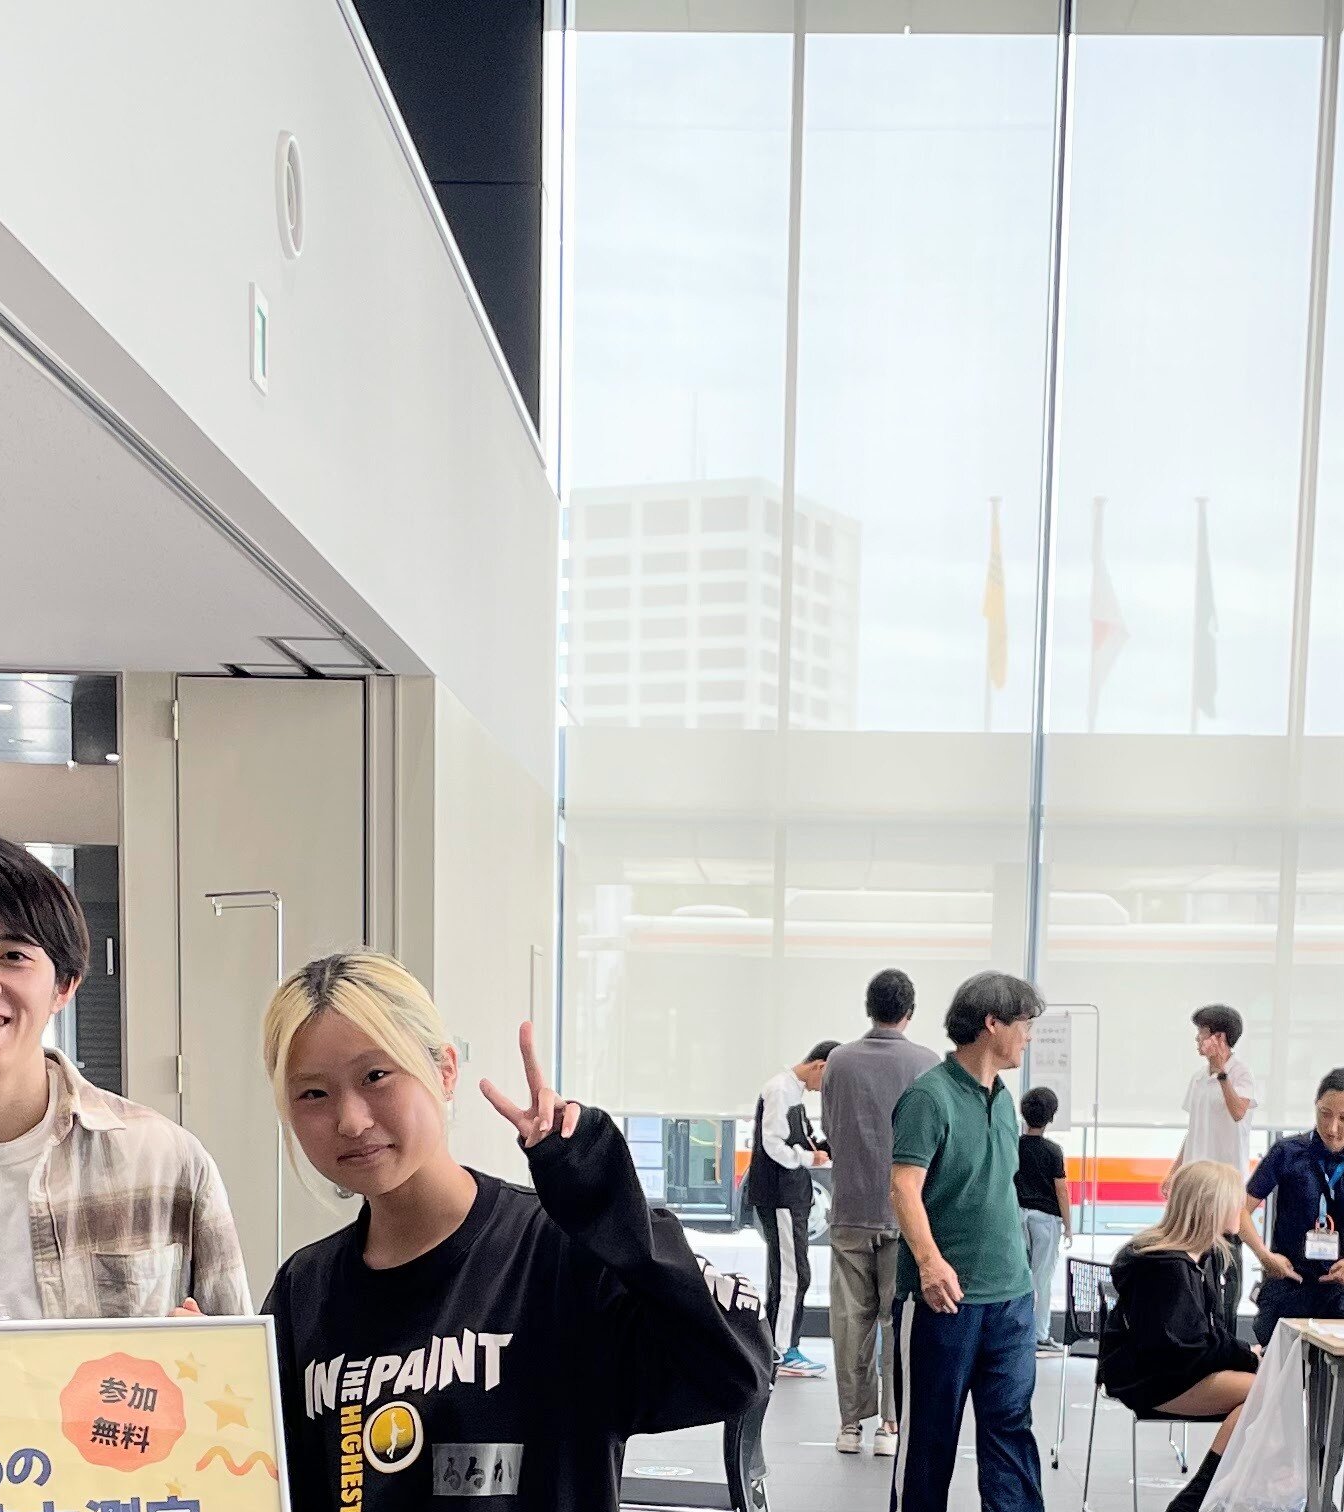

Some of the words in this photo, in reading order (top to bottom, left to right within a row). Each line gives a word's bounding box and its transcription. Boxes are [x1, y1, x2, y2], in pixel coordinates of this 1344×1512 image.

[305, 1354, 345, 1420] IN
[341, 1358, 368, 1402] THE
[365, 1328, 513, 1405] PAINT
[99, 1377, 158, 1412] 参加
[90, 1417, 150, 1453] 無料
